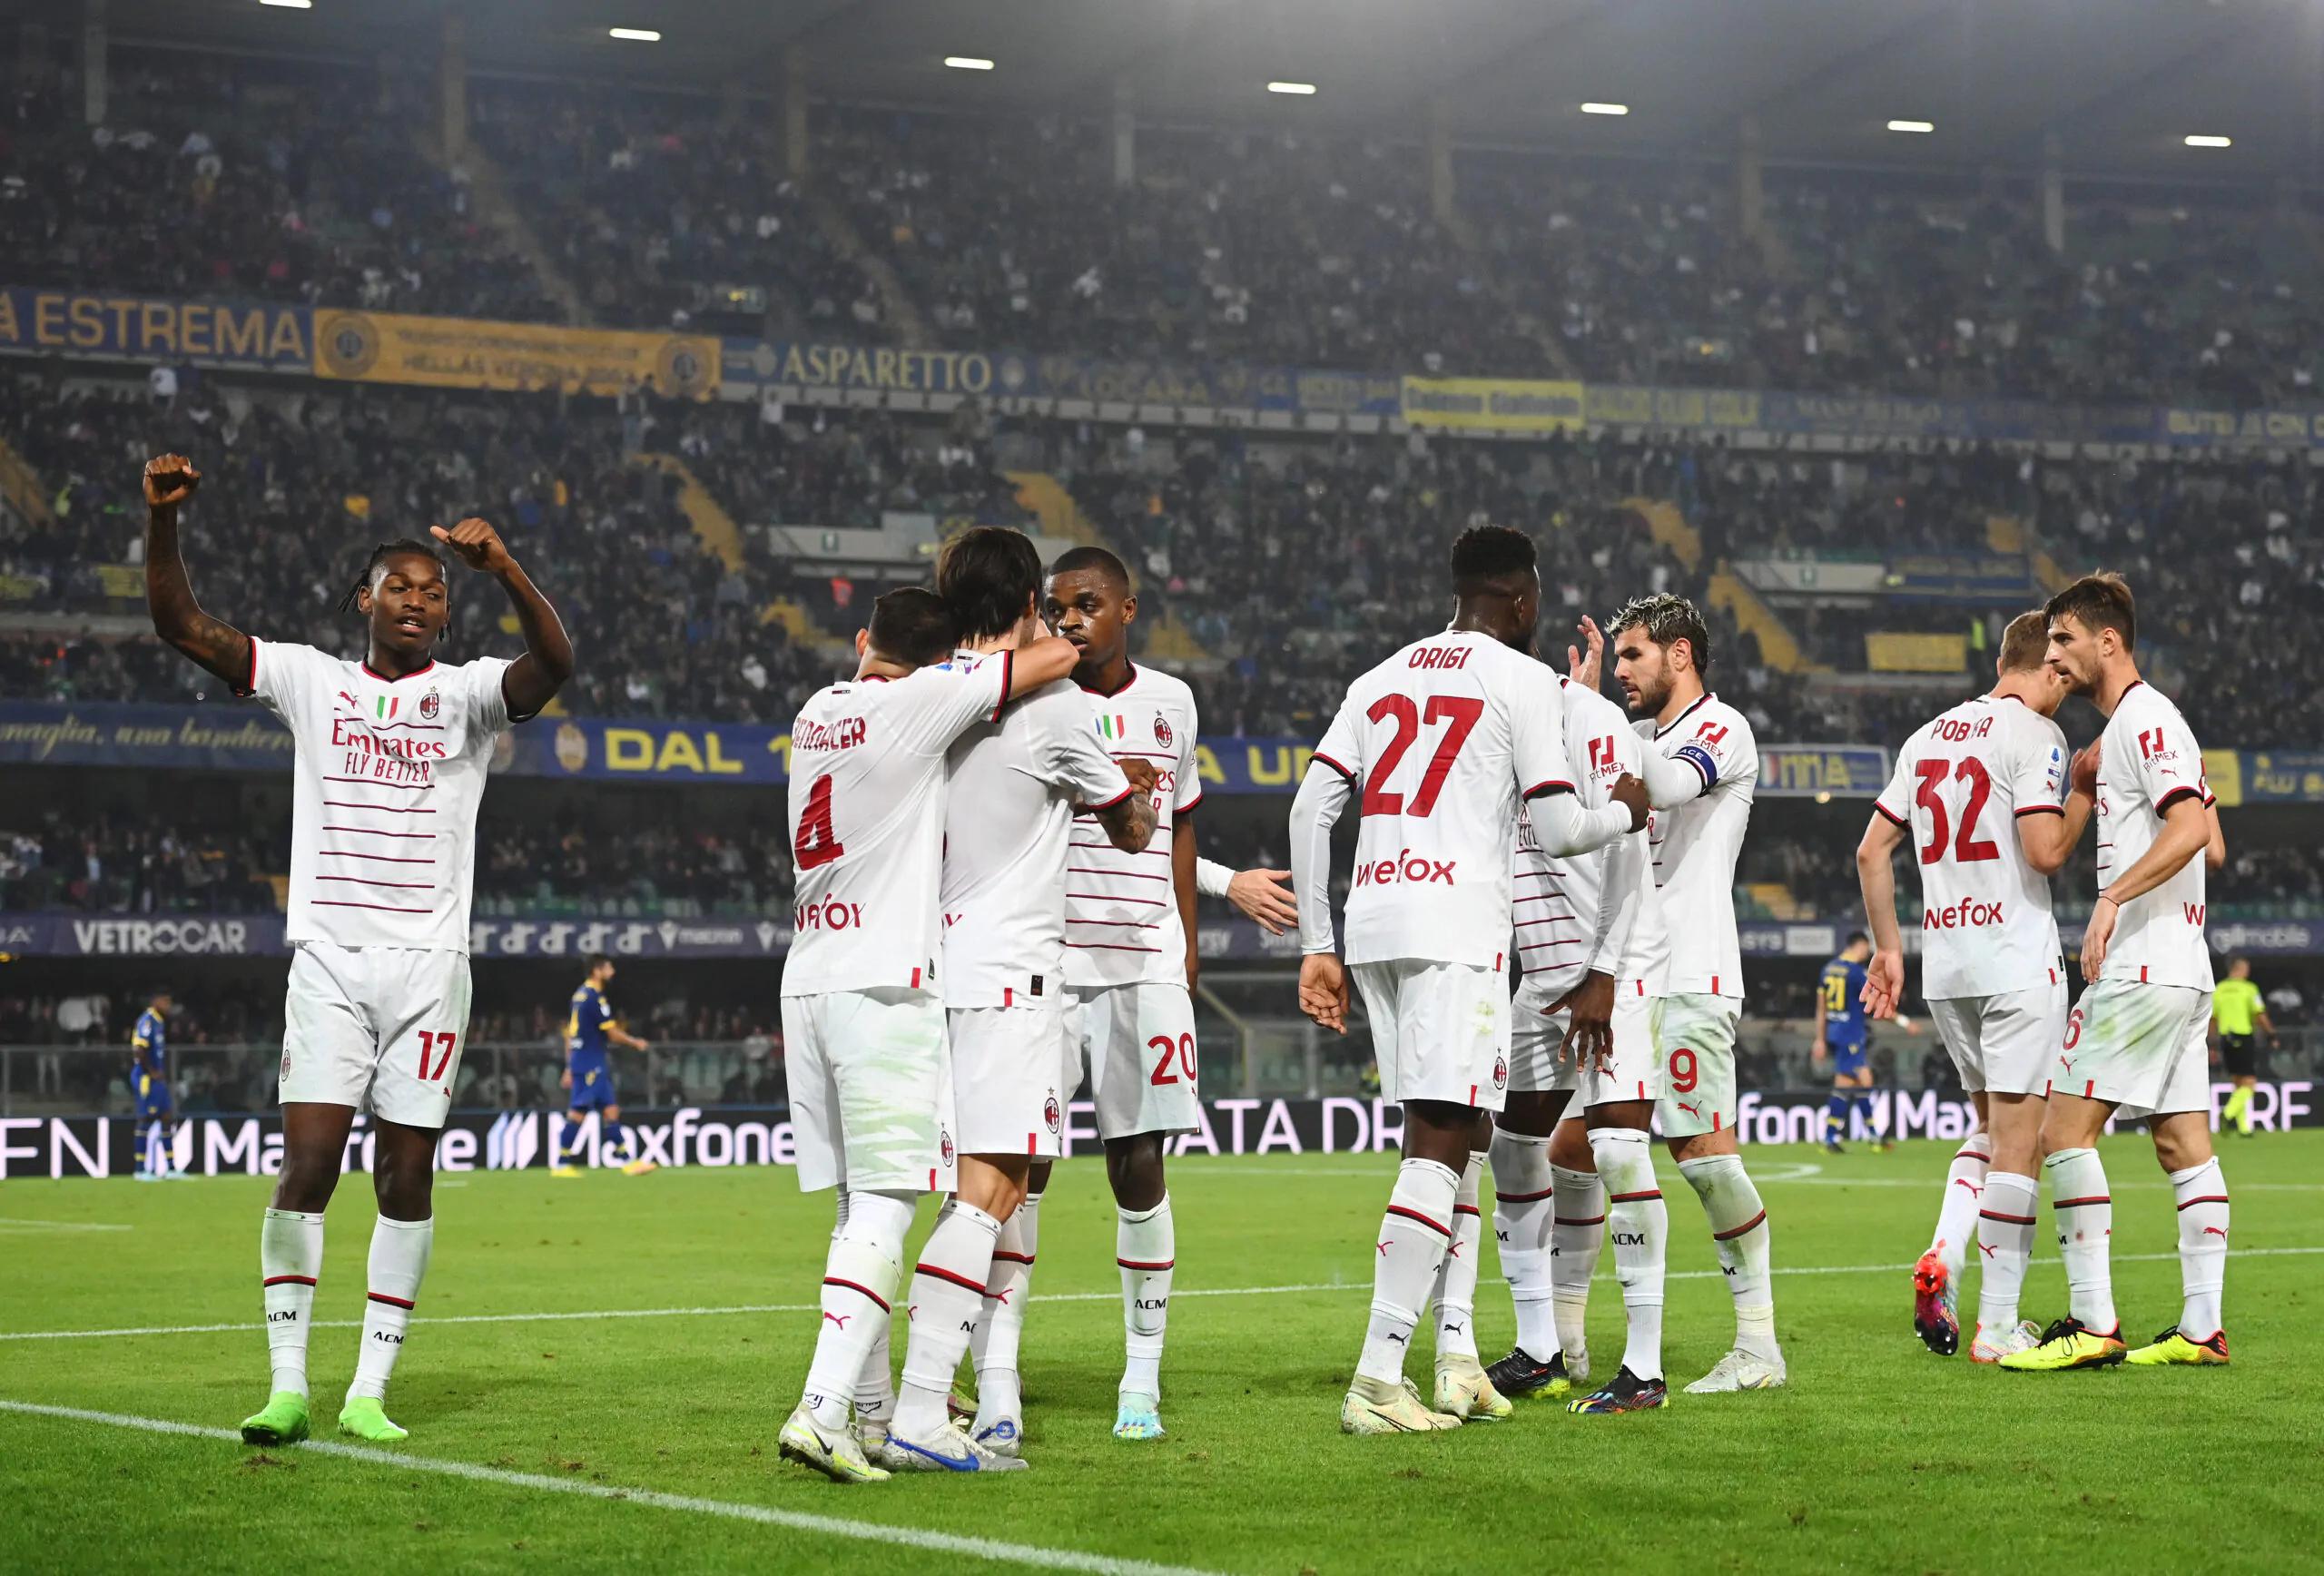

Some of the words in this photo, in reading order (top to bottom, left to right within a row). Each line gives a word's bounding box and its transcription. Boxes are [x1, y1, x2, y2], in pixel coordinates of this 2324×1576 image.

[35, 294, 307, 360] ESTREMA
[783, 342, 992, 392] ASPARETTO
[1408, 647, 1472, 669] ORIGI
[331, 718, 447, 759] Emirates
[606, 729, 743, 773] DAL
[1361, 694, 1485, 817] 27
[344, 752, 371, 775] FLY
[373, 757, 430, 783] BETTER
[2143, 750, 2179, 773] BitMEX
[793, 774, 844, 872] 4
[1915, 756, 2000, 864] 32
[1356, 849, 1456, 887] wefox
[74, 920, 247, 954] VETROCAR
[2063, 1009, 2084, 1050] 6
[418, 1029, 457, 1081] 17
[1147, 1031, 1197, 1087] 20
[1669, 1048, 1698, 1094] 9
[1611, 1232, 1646, 1246] ACM
[267, 1310, 297, 1324] ACM
[1134, 1297, 1167, 1310] ACM
[373, 1330, 405, 1345] ACM
